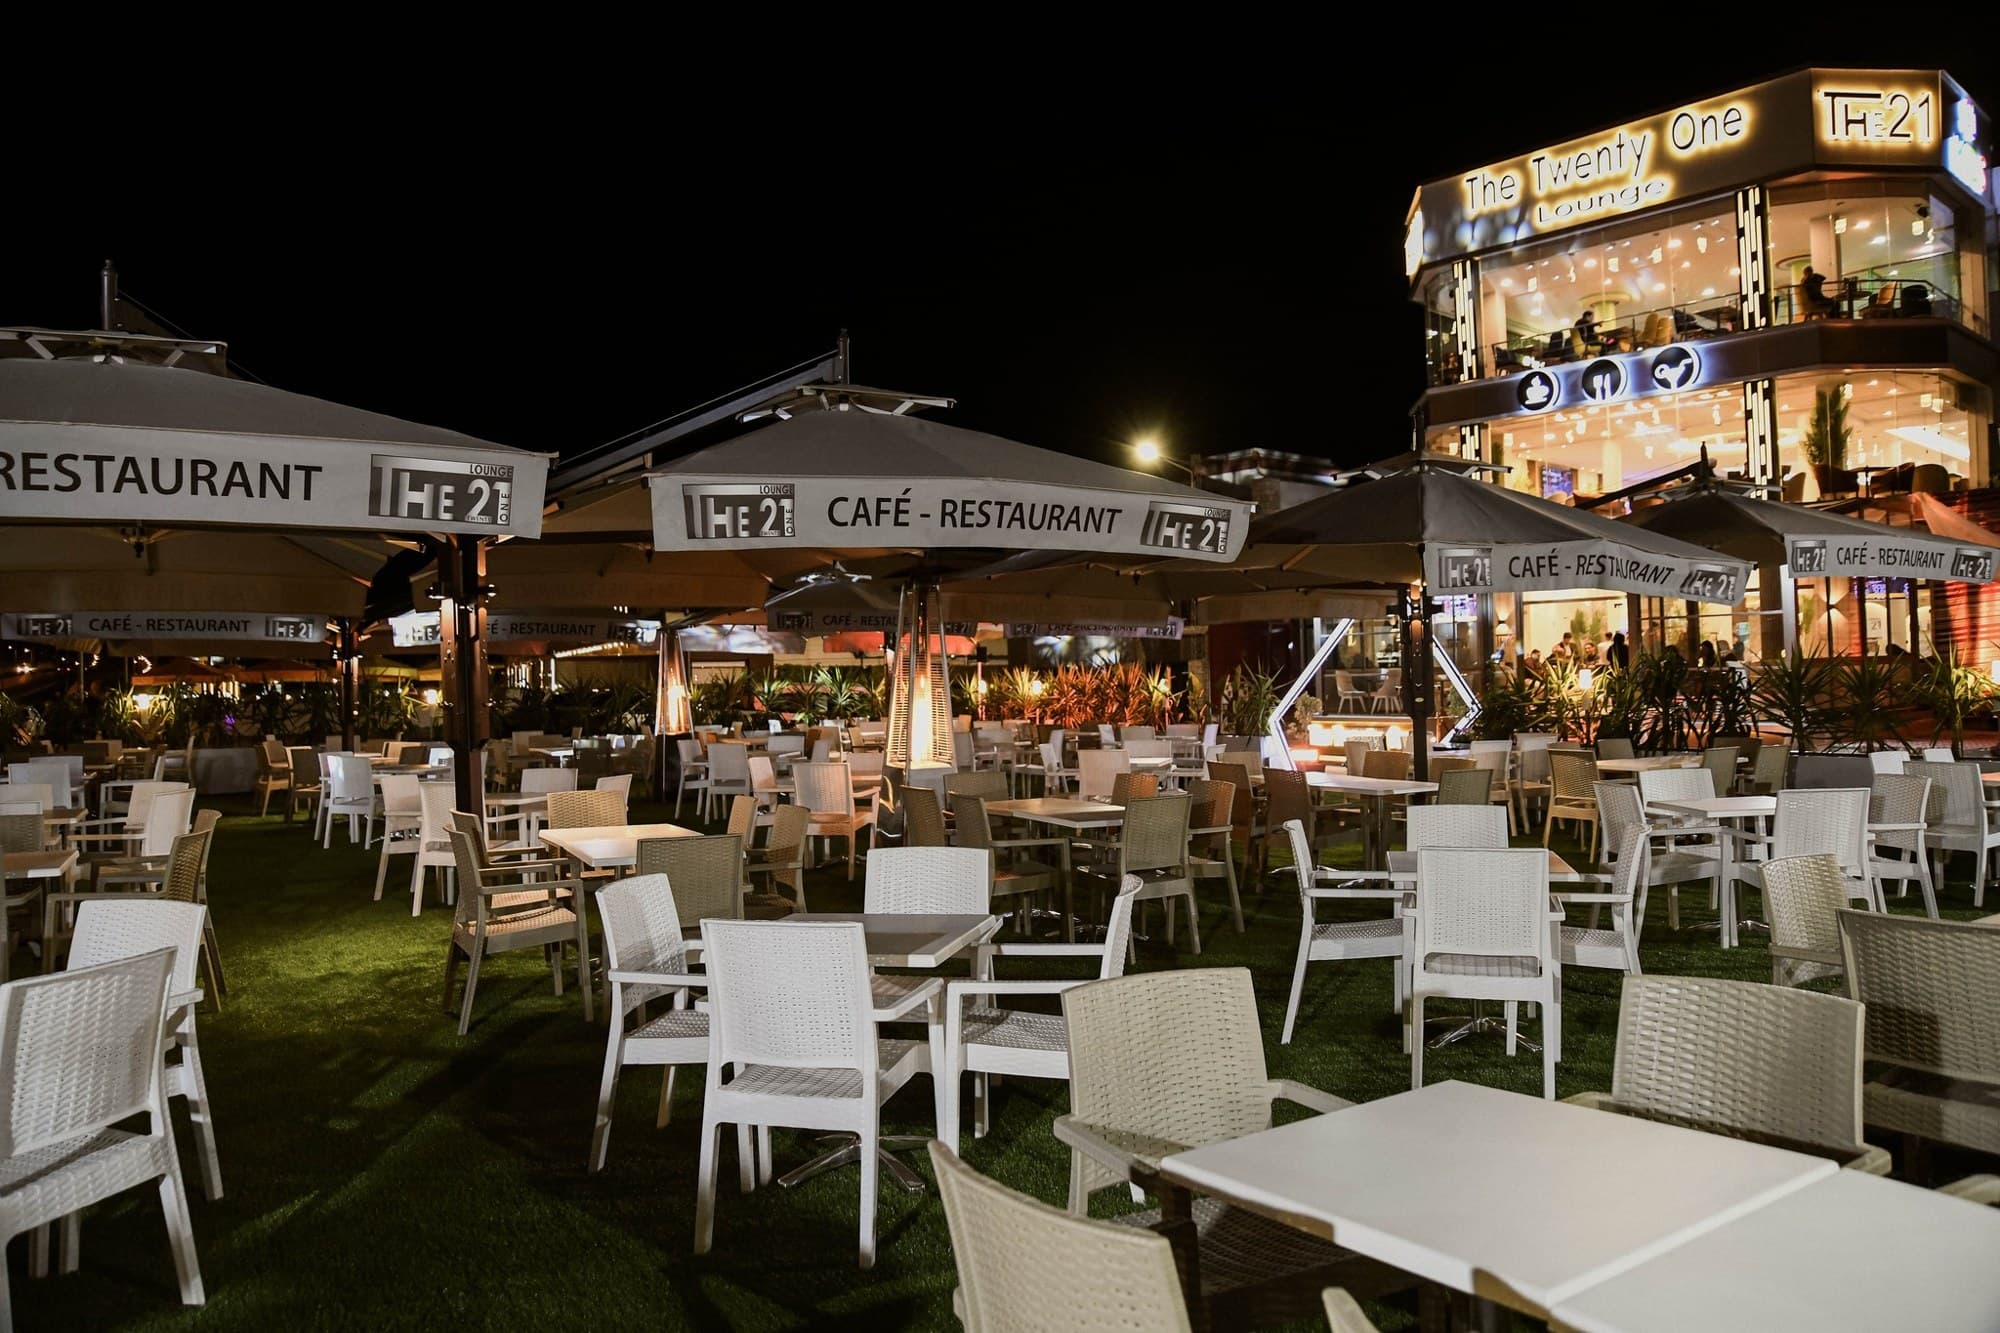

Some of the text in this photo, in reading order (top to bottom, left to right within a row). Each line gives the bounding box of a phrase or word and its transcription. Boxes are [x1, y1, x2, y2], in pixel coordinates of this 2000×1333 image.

[1824, 91, 1930, 137] THE 21
[1466, 106, 1742, 209] The Twenty One
[1538, 180, 1665, 222] Lounge
[470, 464, 513, 477] LOUNGE
[372, 455, 512, 524] THE 21
[499, 493, 510, 522] ONE
[683, 485, 793, 538] THE 21
[828, 488, 912, 527] CAFÉ
[940, 499, 1122, 533] RESTAURANT
[1146, 502, 1228, 553] THE 21
[1440, 549, 1471, 587] THE
[1508, 548, 1560, 578] CAFÉ
[1576, 554, 1675, 585] RESTAURANT
[1792, 541, 1811, 571] THE
[1837, 541, 1868, 565] CAFÉ
[1879, 548, 1945, 569] RESTAURANT
[1952, 549, 1974, 577] THE
[1683, 564, 1713, 597] THE
[89, 614, 132, 632] CAFÉ
[147, 618, 251, 633] RESTAURANT
[510, 621, 595, 637] RESTAURANT
